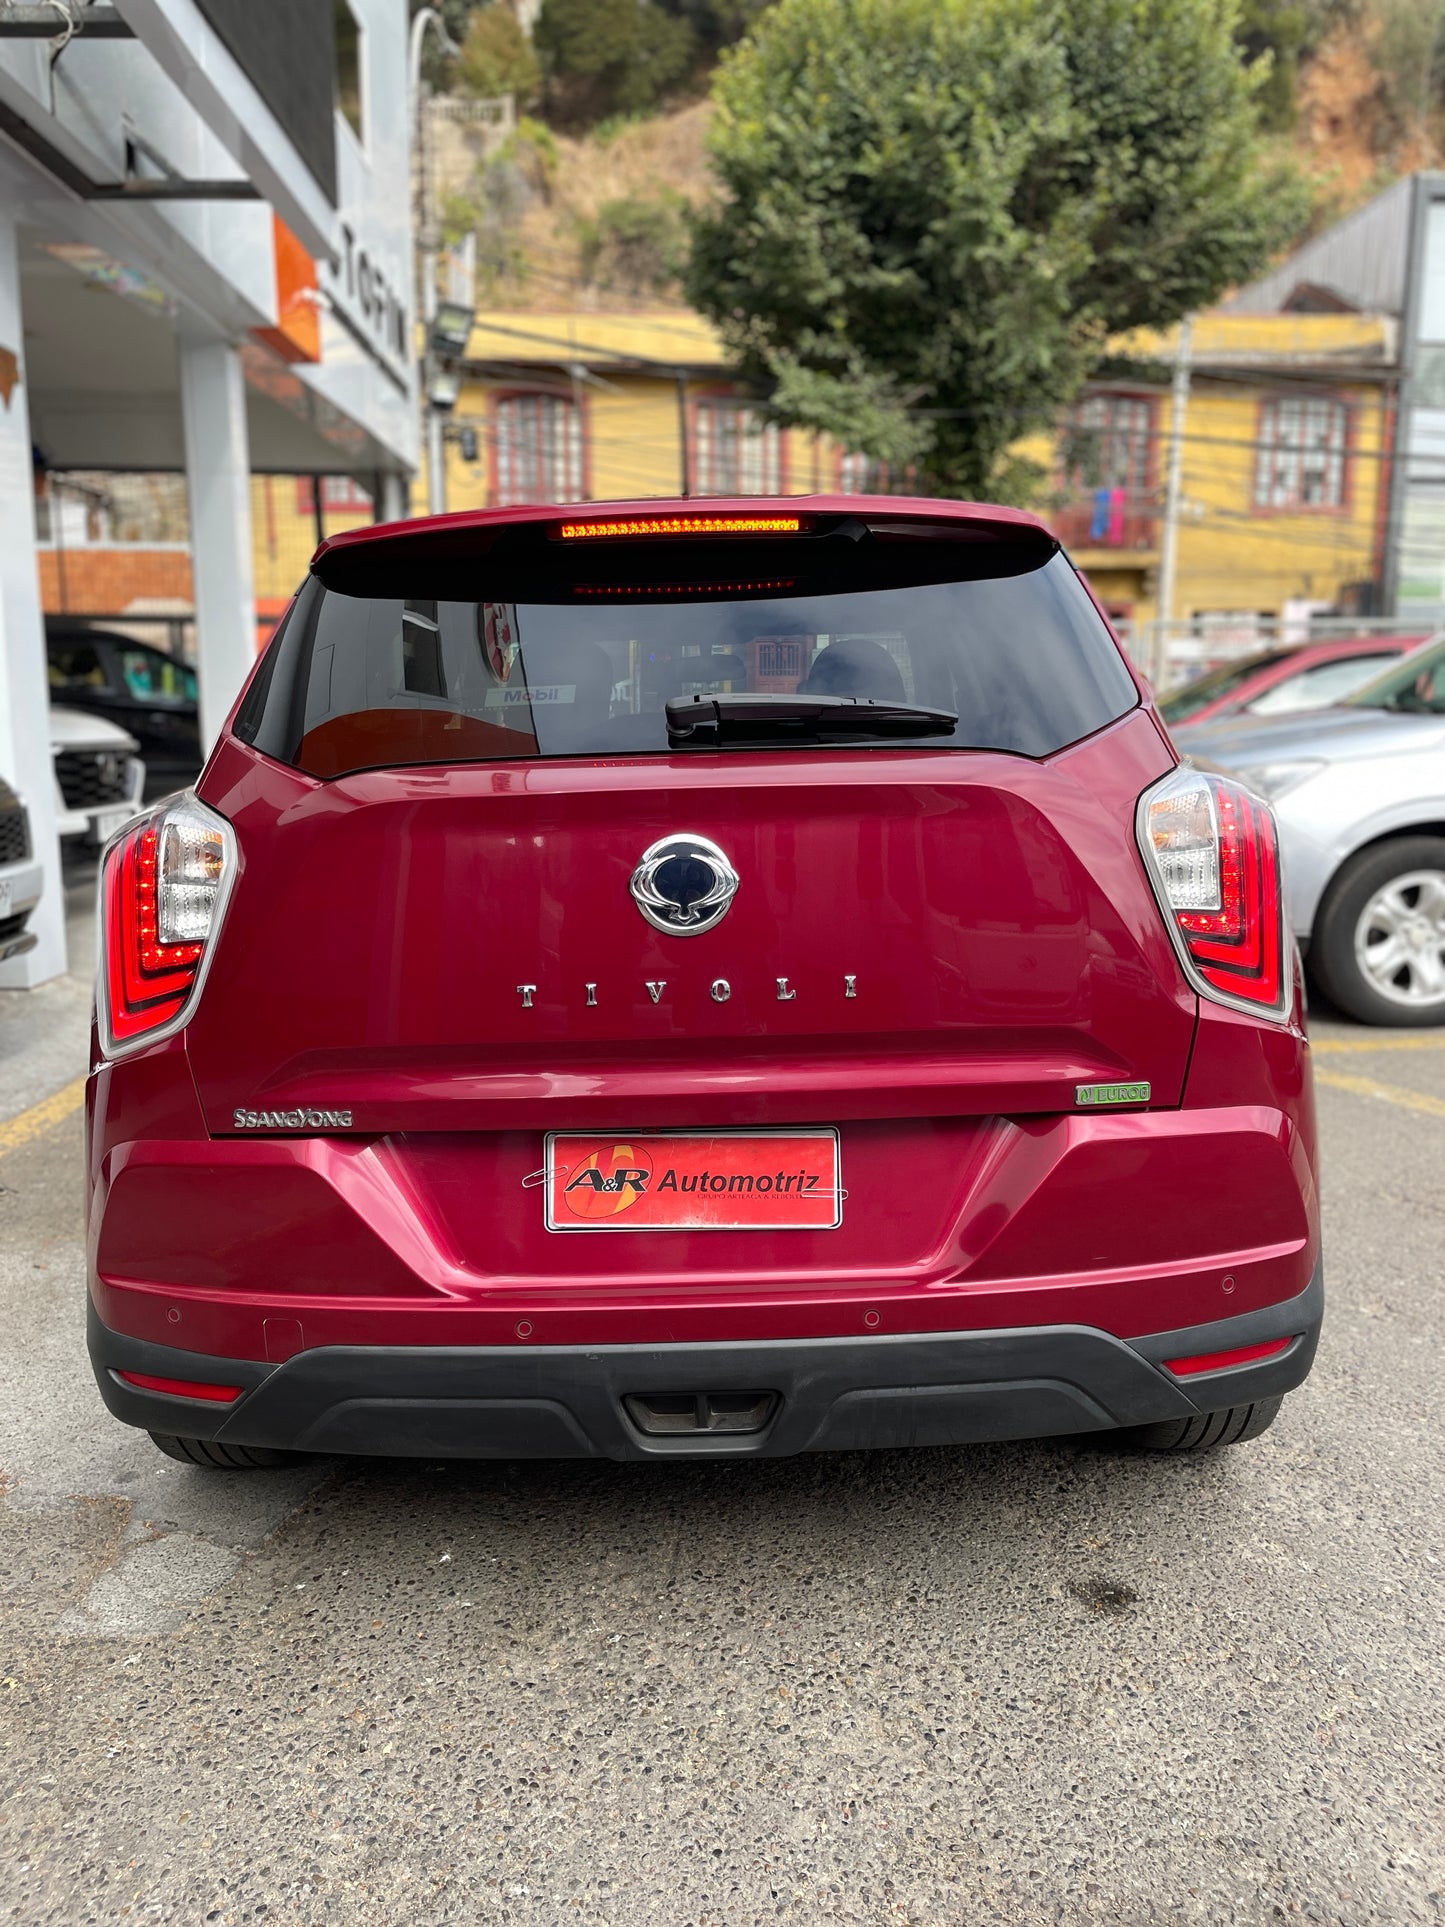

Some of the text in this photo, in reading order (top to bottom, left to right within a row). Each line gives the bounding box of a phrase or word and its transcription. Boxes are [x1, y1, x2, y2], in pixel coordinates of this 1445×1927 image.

[504, 688, 559, 703] Mobil
[516, 974, 857, 1008] TIVOLI
[564, 1168, 821, 1193] A&R Automotriz
